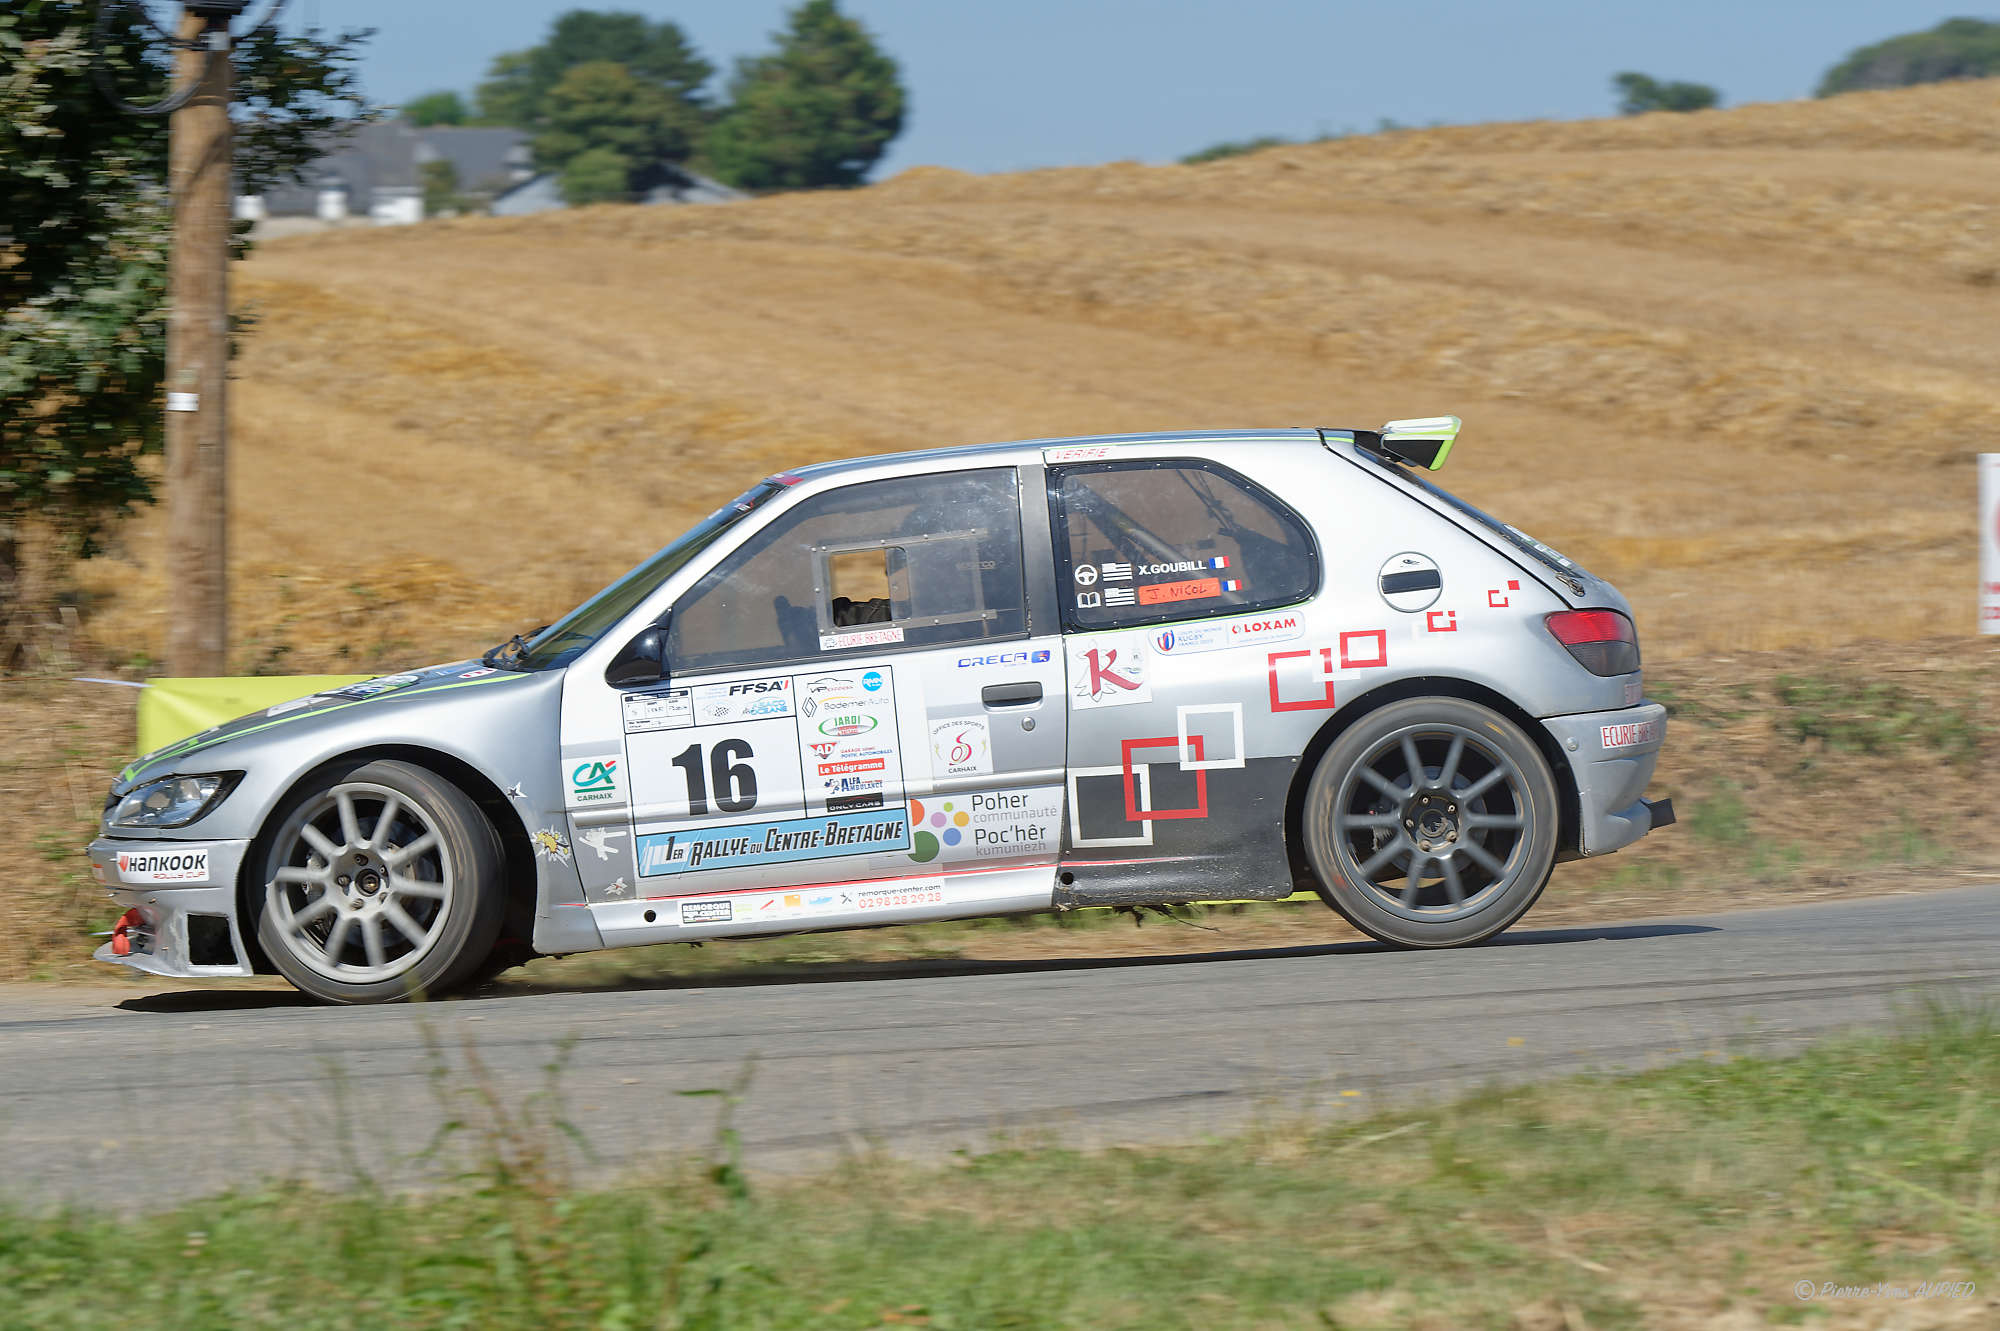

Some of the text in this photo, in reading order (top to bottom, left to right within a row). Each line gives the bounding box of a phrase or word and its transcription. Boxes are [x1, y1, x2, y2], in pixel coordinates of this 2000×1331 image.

[1244, 618, 1297, 633] LOXAM
[729, 681, 782, 696] FFSA
[1602, 724, 1637, 747] ECURIE
[819, 762, 884, 774] Le Télégramme
[948, 765, 977, 774] CARHAIX
[671, 738, 758, 816] 16
[577, 792, 613, 802] CARHAIX
[971, 792, 1029, 811] Poher
[973, 807, 1058, 824] communauté
[975, 824, 1048, 845] Poc'hêr
[689, 837, 750, 866] RALLYE
[750, 843, 762, 855] DU
[764, 821, 905, 853] CENTRE-BRETAGNE
[975, 841, 1048, 857] kumuniezh
[858, 884, 942, 897] remorque-center.com
[858, 898, 875, 909] 02
[876, 896, 891, 907] 98
[893, 895, 908, 905] 28
[927, 892, 943, 902] 28
